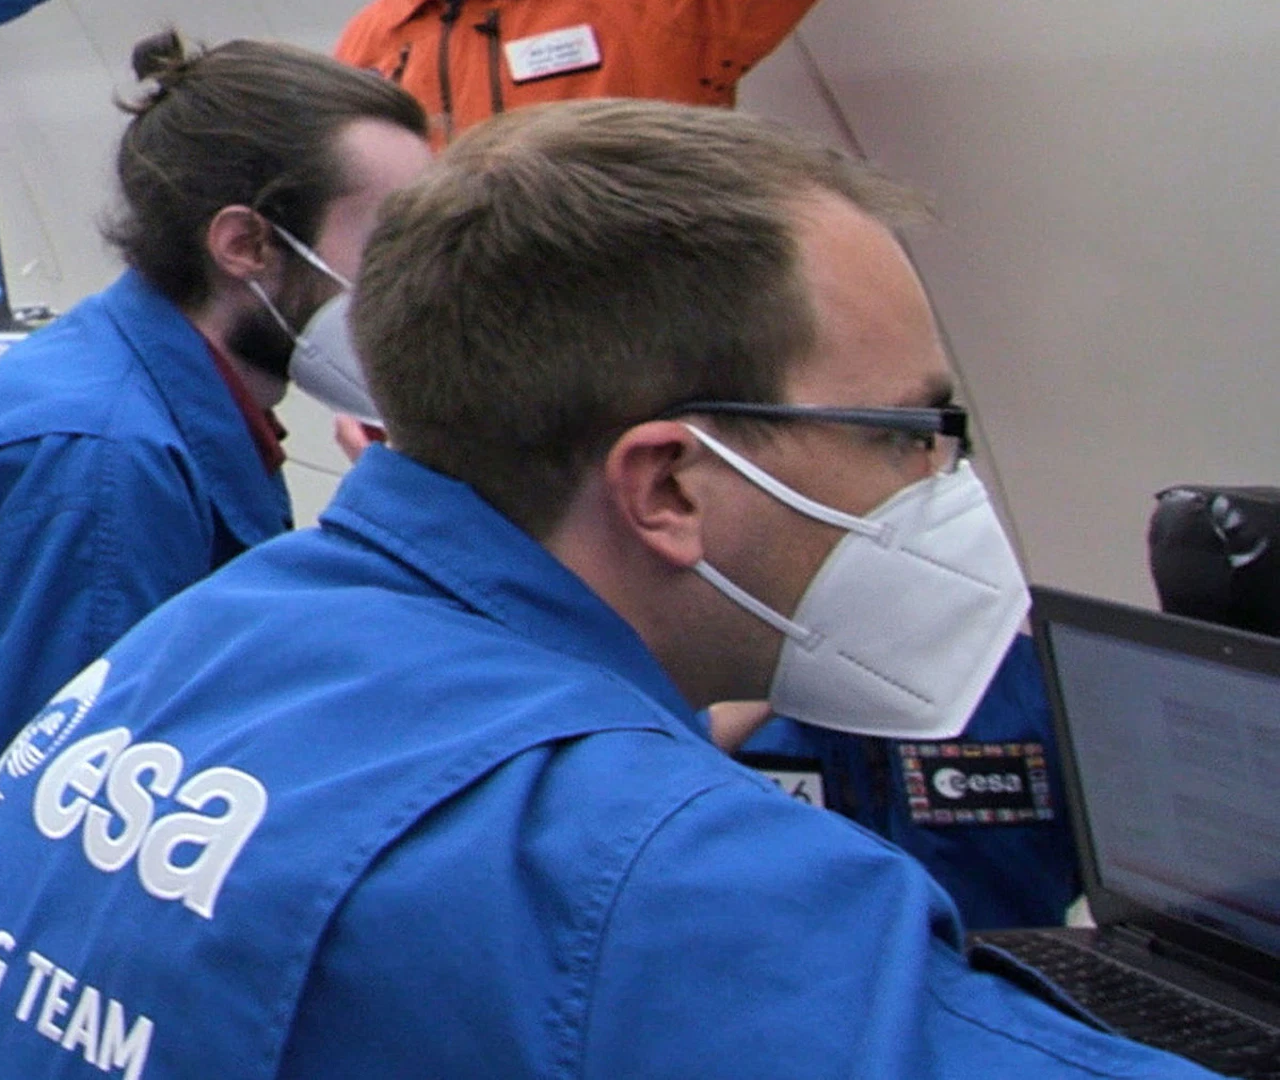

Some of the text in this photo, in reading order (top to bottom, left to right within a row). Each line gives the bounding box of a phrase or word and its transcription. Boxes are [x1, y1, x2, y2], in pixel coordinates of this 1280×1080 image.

[33, 726, 269, 921] esa
[967, 772, 1023, 794] esa
[15, 950, 155, 1080] TEAM
